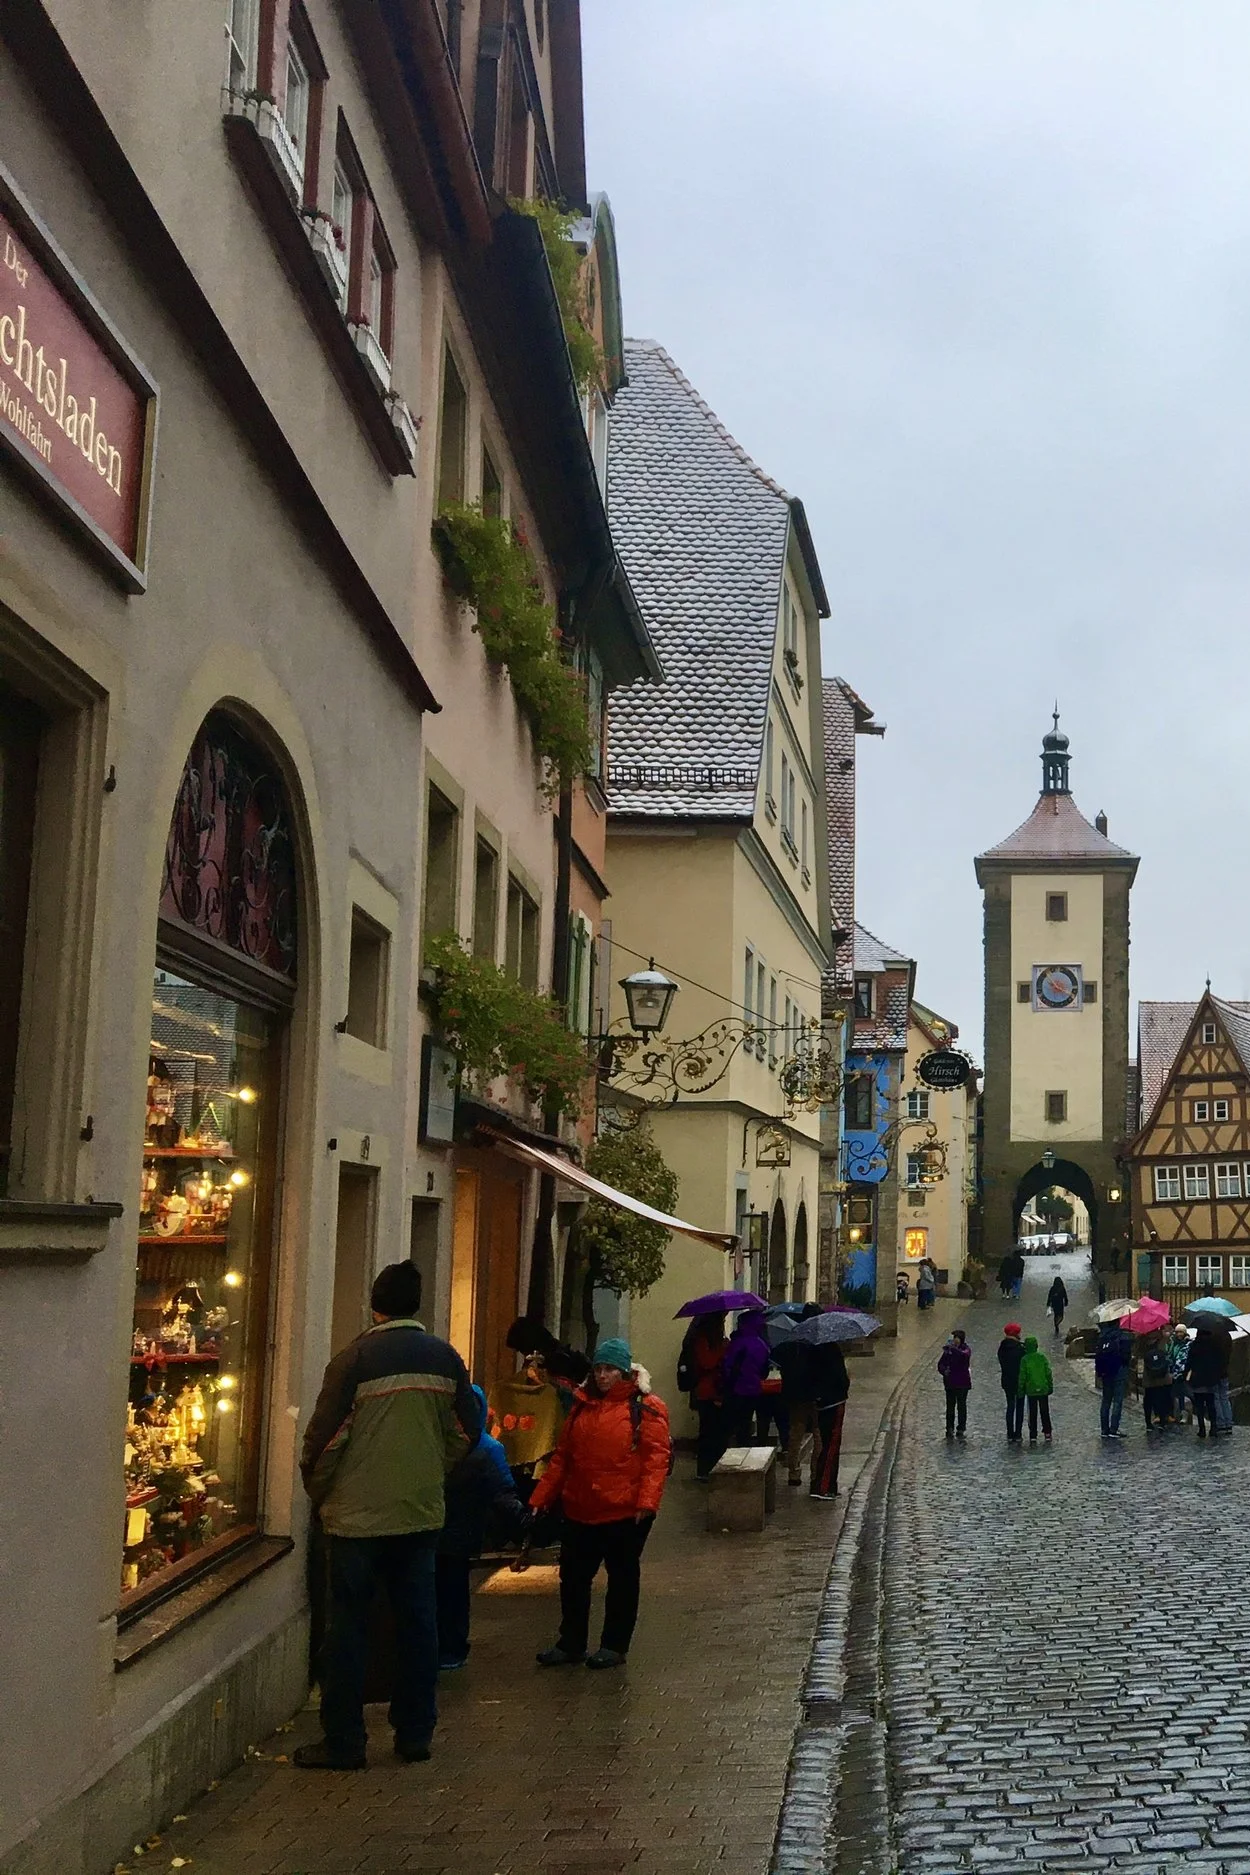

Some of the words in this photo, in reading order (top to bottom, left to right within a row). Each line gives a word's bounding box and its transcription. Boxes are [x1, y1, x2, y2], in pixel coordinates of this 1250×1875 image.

[4, 233, 29, 287] Der
[0, 304, 122, 497] chtsladen
[928, 1065, 960, 1076] Hirsch
